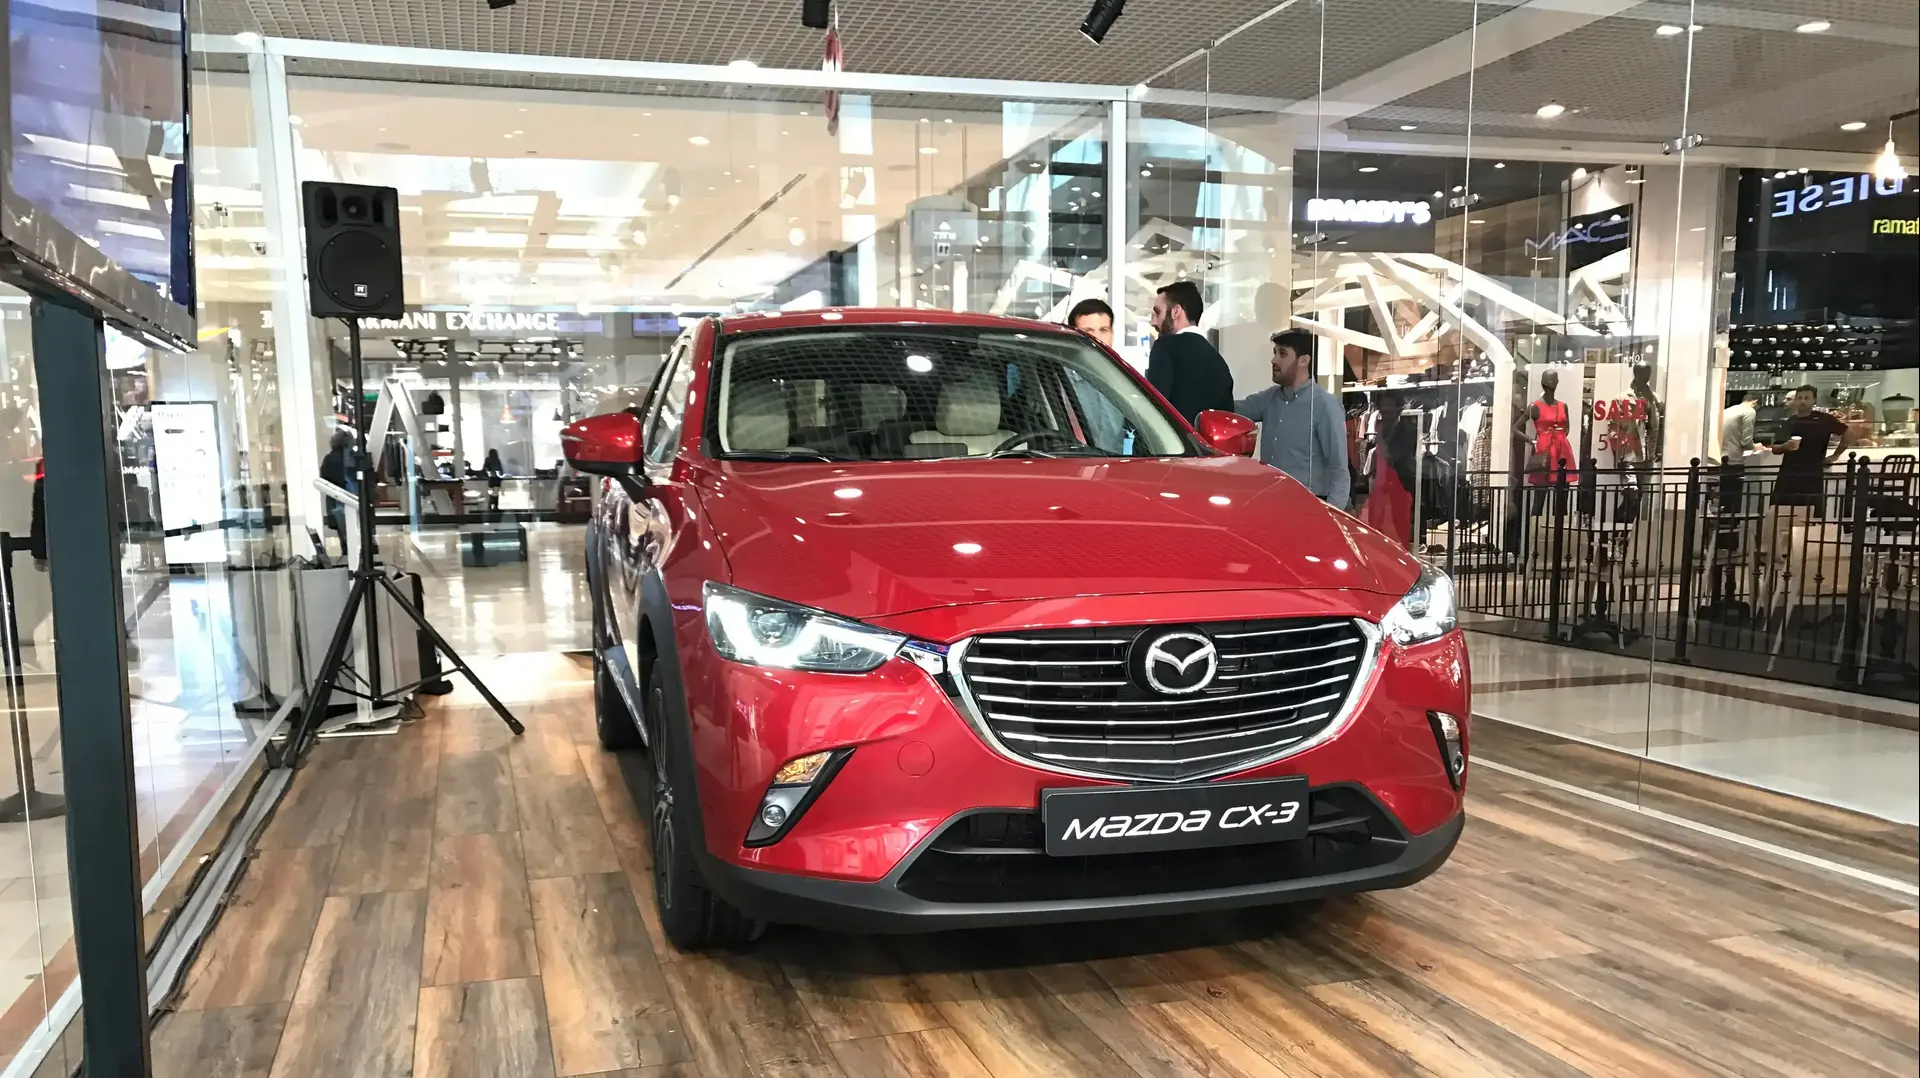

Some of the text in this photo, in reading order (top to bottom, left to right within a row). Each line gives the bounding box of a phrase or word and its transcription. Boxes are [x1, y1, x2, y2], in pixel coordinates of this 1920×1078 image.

[445, 312, 561, 331] EXCHANGE
[1594, 399, 1648, 421] SALE
[1218, 801, 1300, 829] CX-3
